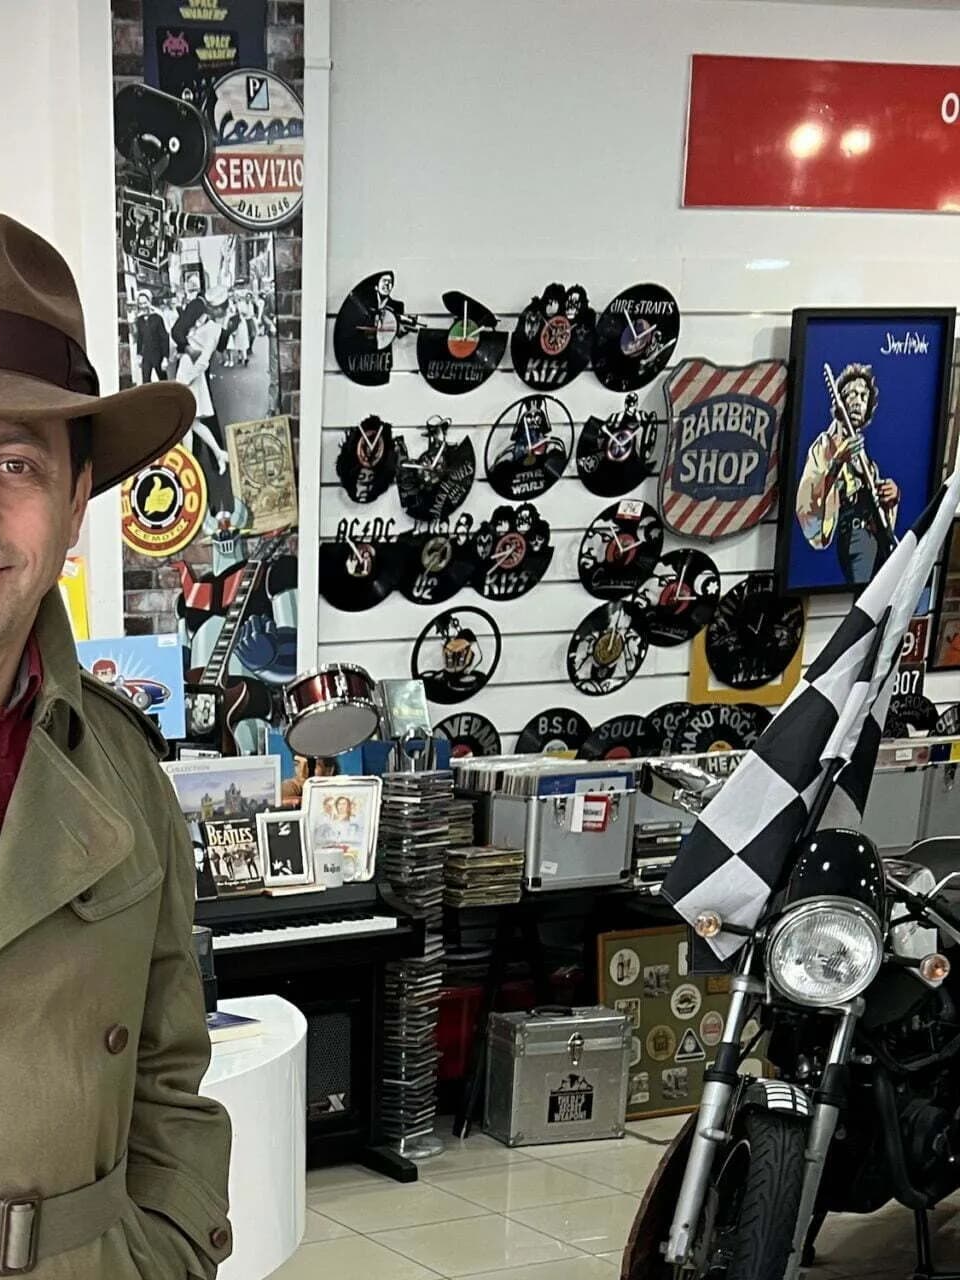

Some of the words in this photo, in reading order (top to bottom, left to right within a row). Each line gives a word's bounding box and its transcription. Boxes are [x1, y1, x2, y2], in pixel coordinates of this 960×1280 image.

[215, 158, 304, 189] SERVIZIO
[238, 199, 261, 218] DAL
[267, 197, 290, 218] 1946
[680, 401, 771, 450] BARBER
[678, 450, 759, 487] SHOP
[412, 574, 438, 600] U2
[599, 718, 646, 741] SOUL
[681, 709, 714, 753] HARD
[719, 707, 758, 747] ROCK
[205, 824, 254, 847] BEATLES
